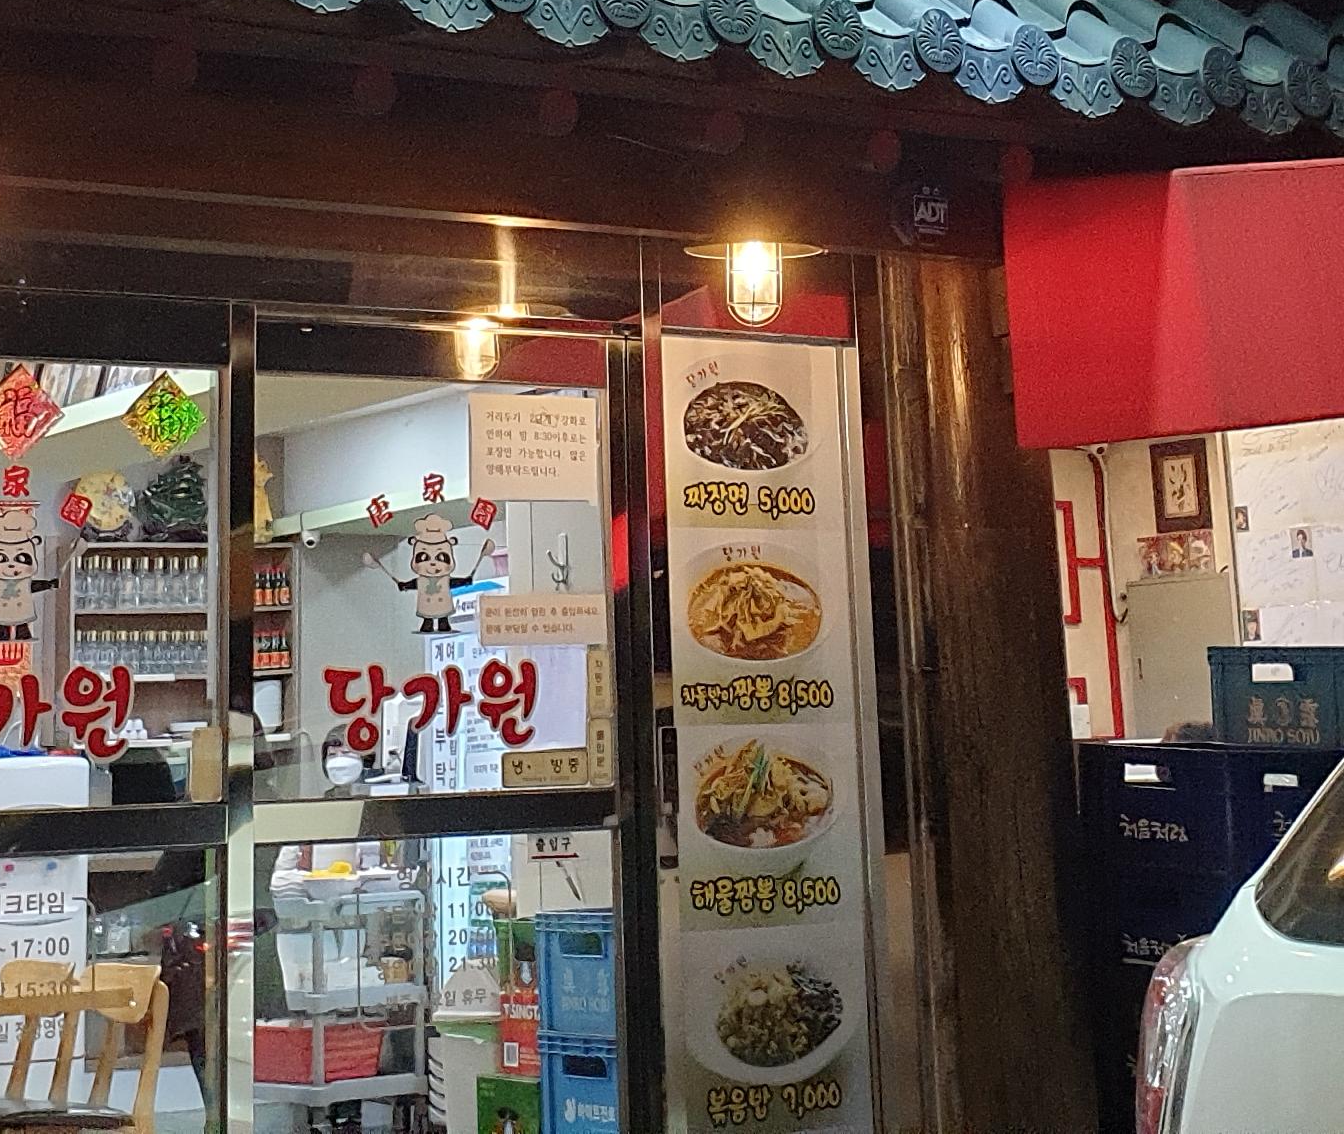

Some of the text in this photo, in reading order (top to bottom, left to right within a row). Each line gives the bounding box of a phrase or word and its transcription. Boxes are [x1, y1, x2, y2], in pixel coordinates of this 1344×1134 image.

[916, 201, 948, 225] ADT
[683, 481, 816, 520] 짜장면 5,000
[323, 659, 538, 750] 당가원
[776, 679, 834, 715] 8,500
[1119, 813, 1190, 842] 처음처럼
[397, 867, 471, 890] 영시간
[448, 900, 494, 918] 1100
[690, 875, 840, 916] 해물짬뽕 8,500
[461, 987, 487, 1006] 휴무
[781, 1080, 842, 1120] 7,000
